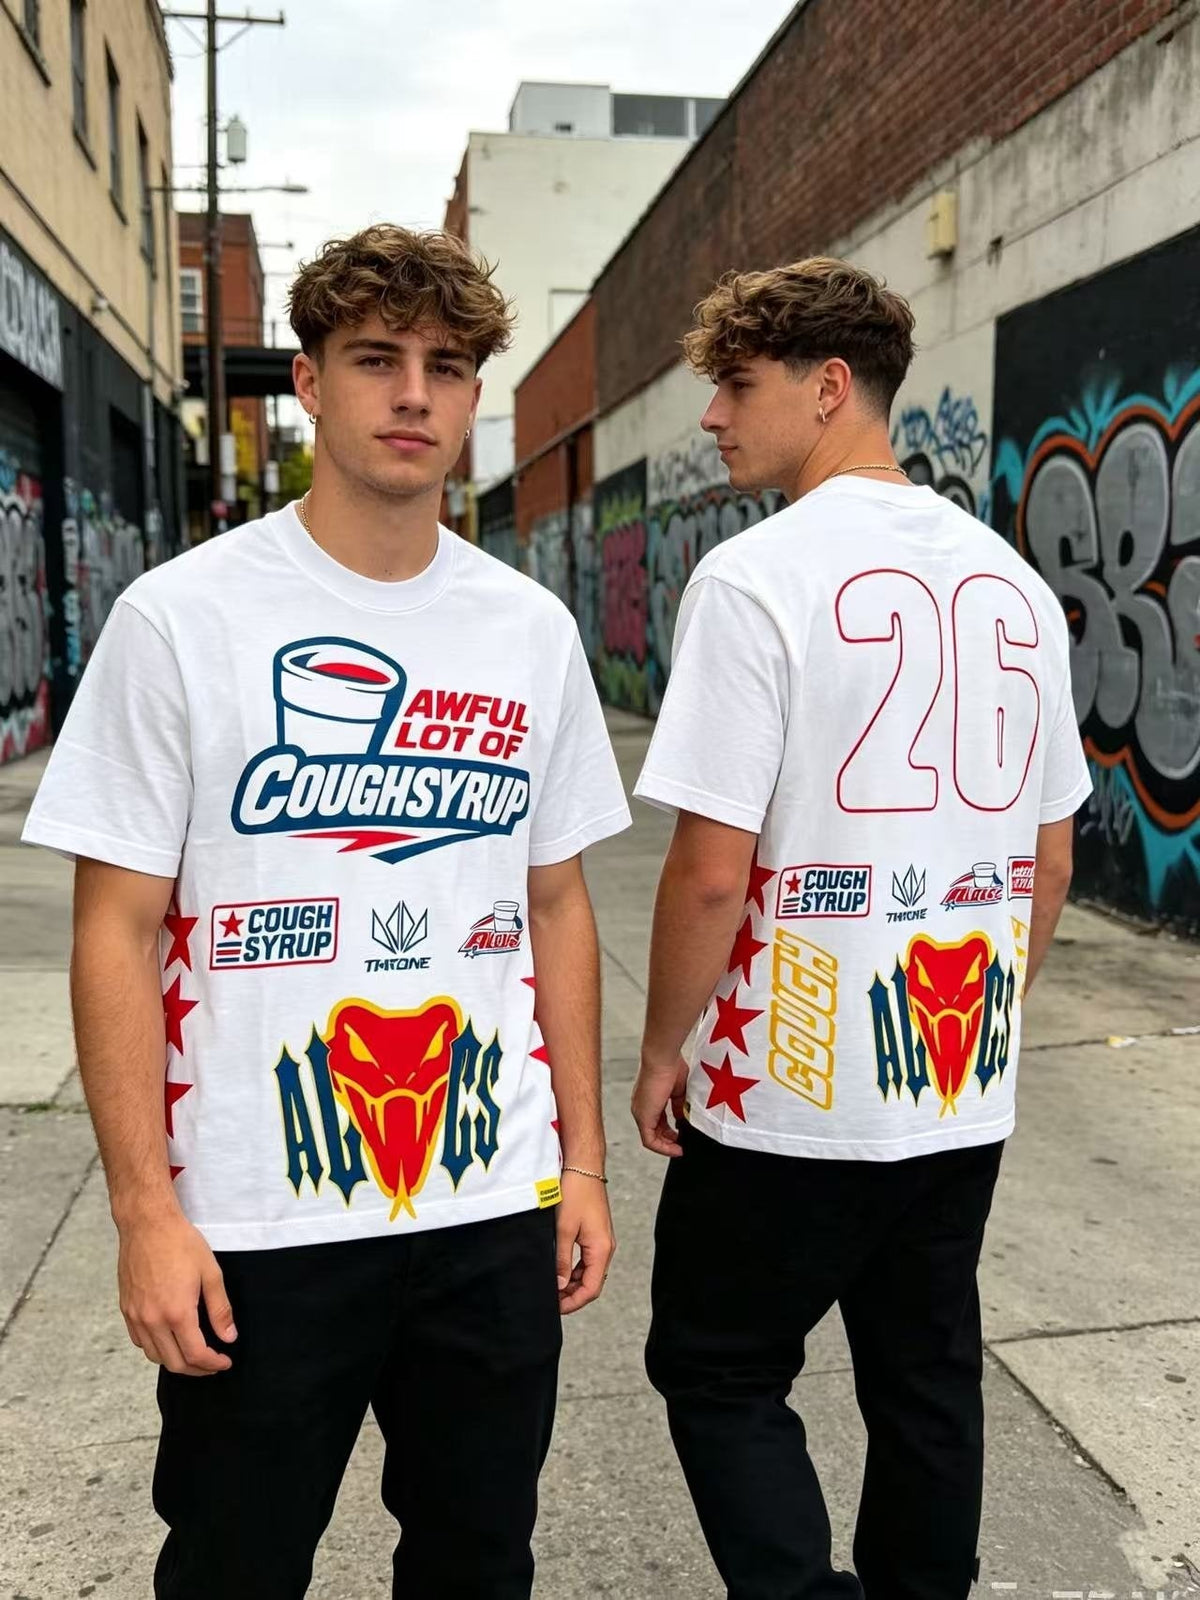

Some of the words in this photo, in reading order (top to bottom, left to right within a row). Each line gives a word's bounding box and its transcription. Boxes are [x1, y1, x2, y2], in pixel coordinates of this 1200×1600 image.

[835, 568, 1040, 813] 26
[404, 689, 529, 733] AWFUL
[394, 722, 474, 752] LOT
[479, 731, 523, 760] OF
[239, 754, 528, 826] COUGHSYRUP
[803, 869, 868, 891] COUGH
[248, 903, 334, 932] COUGH
[800, 891, 868, 914] SYRUP
[243, 932, 333, 963] SYRUP
[766, 927, 840, 1111] COUGH
